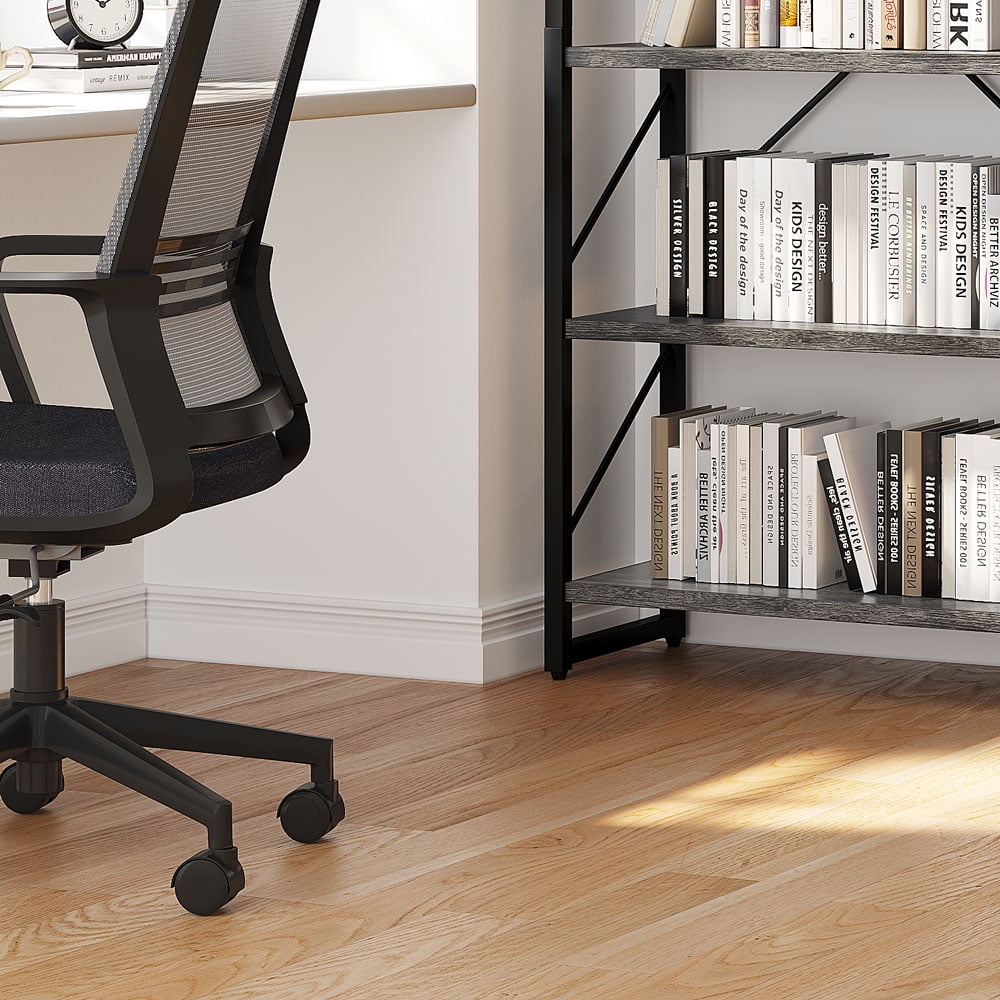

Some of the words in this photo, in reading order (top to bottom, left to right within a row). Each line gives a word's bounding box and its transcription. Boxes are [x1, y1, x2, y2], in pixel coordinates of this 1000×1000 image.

[74, 1, 79, 9] 9
[125, 0, 131, 8] 3
[101, 28, 107, 36] 6
[932, 12, 942, 49] WHO
[106, 53, 138, 62] AMERICAN
[139, 52, 161, 61] BEAUTY
[109, 74, 130, 82] REMIX
[738, 189, 748, 212] Day
[870, 168, 879, 204] DESIGN
[888, 191, 900, 210] LE
[939, 169, 948, 206] DESIGN
[672, 198, 682, 235] SILVER
[708, 201, 717, 234] BLACK
[740, 216, 748, 230] of
[791, 201, 802, 234] KIDS
[817, 203, 828, 238] design
[870, 207, 879, 250] FESTIVAL
[939, 210, 948, 251] FESTIVAL
[956, 206, 967, 240] KIDS
[740, 232, 748, 252] the
[989, 218, 999, 257] BETTER
[672, 240, 682, 278] DESIGN
[708, 239, 717, 278] DESIGN
[791, 239, 802, 292] DESIGN
[888, 213, 900, 300] CORBUSIER
[956, 244, 967, 298] DESIGN
[738, 255, 748, 296] design
[989, 260, 999, 308] ARCHVIZ
